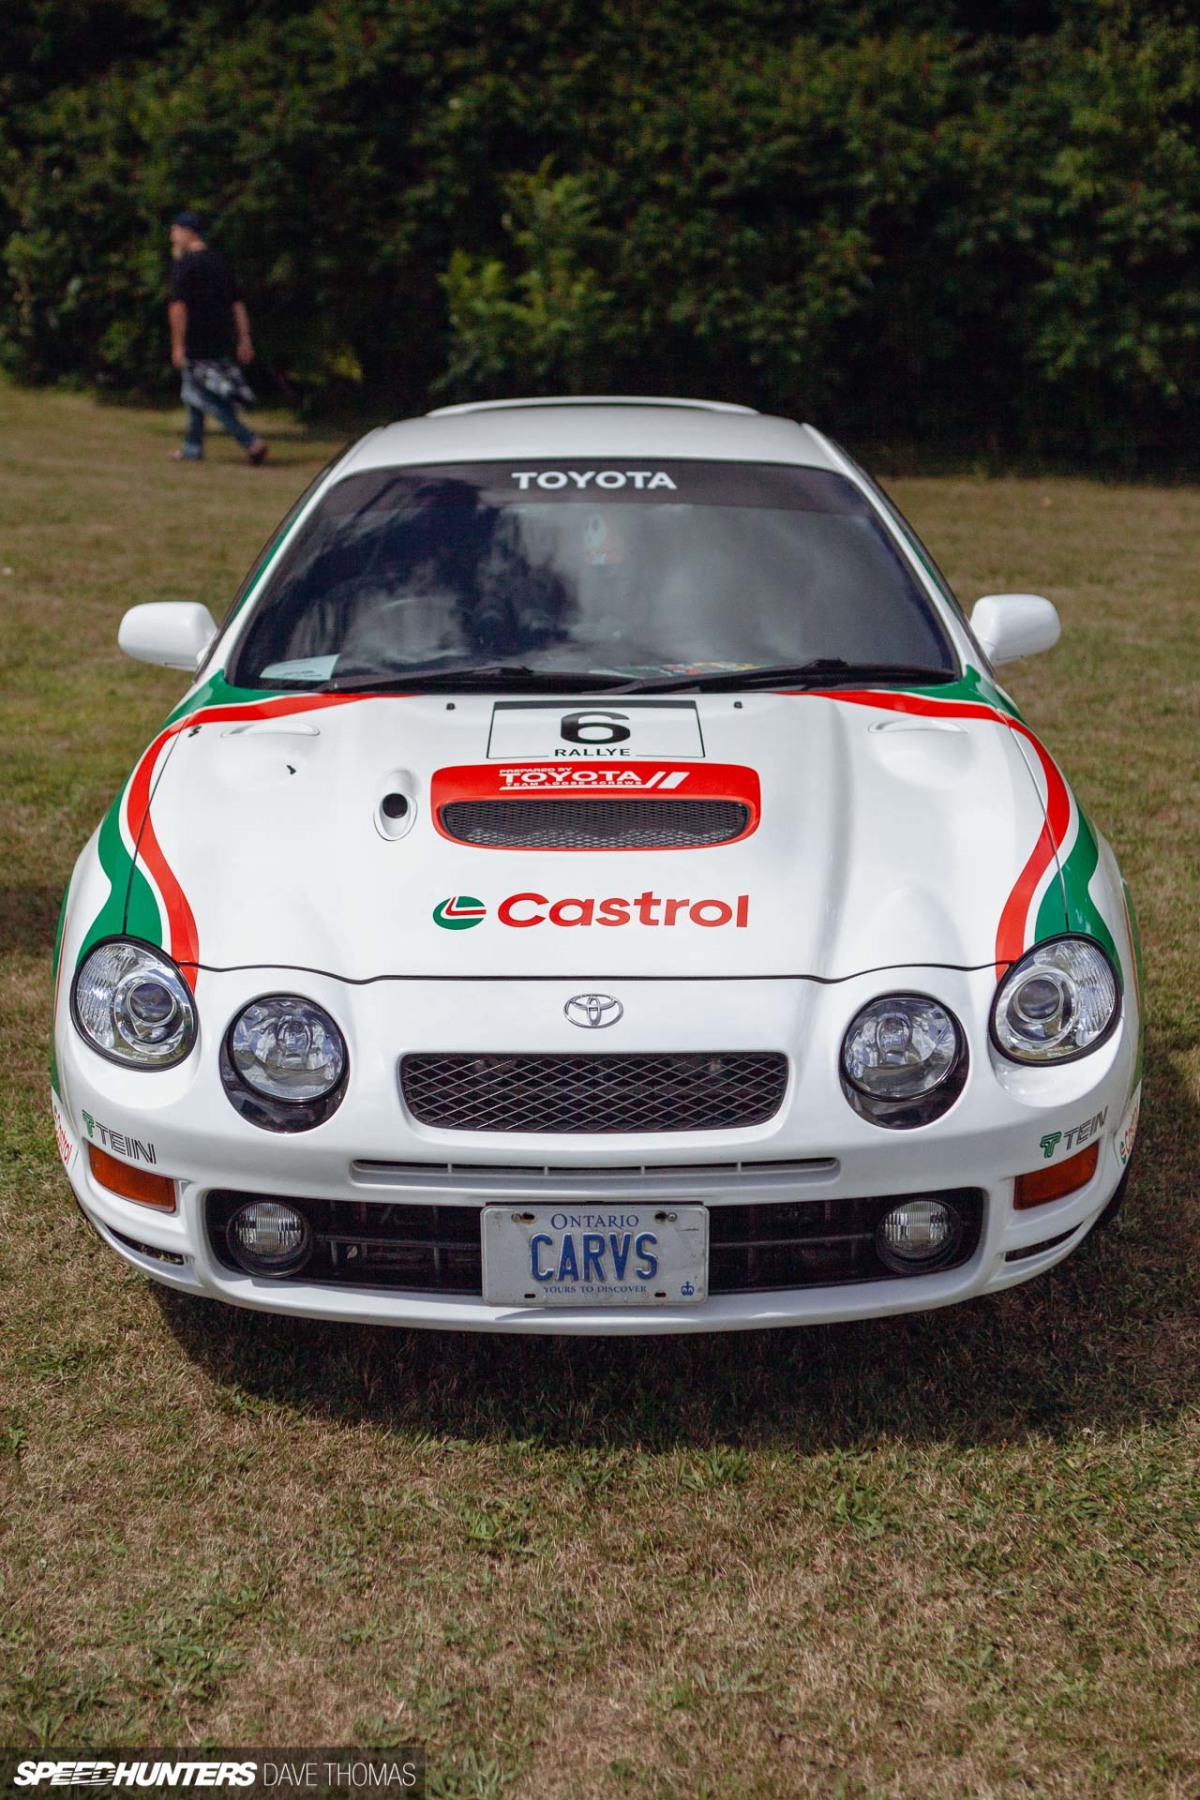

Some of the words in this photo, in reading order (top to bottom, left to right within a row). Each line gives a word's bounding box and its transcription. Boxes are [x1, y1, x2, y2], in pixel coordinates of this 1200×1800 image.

[511, 471, 677, 489] TOYOTA
[560, 711, 631, 744] 6
[554, 748, 631, 757] RALLYE
[499, 771, 642, 783] TOYOTA
[497, 891, 749, 928] Castrol
[95, 1121, 157, 1165] TEIN
[1063, 1105, 1108, 1151] TEIN
[530, 1231, 658, 1281] CARVS
[542, 1286, 577, 1294] YOURS
[597, 1285, 648, 1293] DISCOVER
